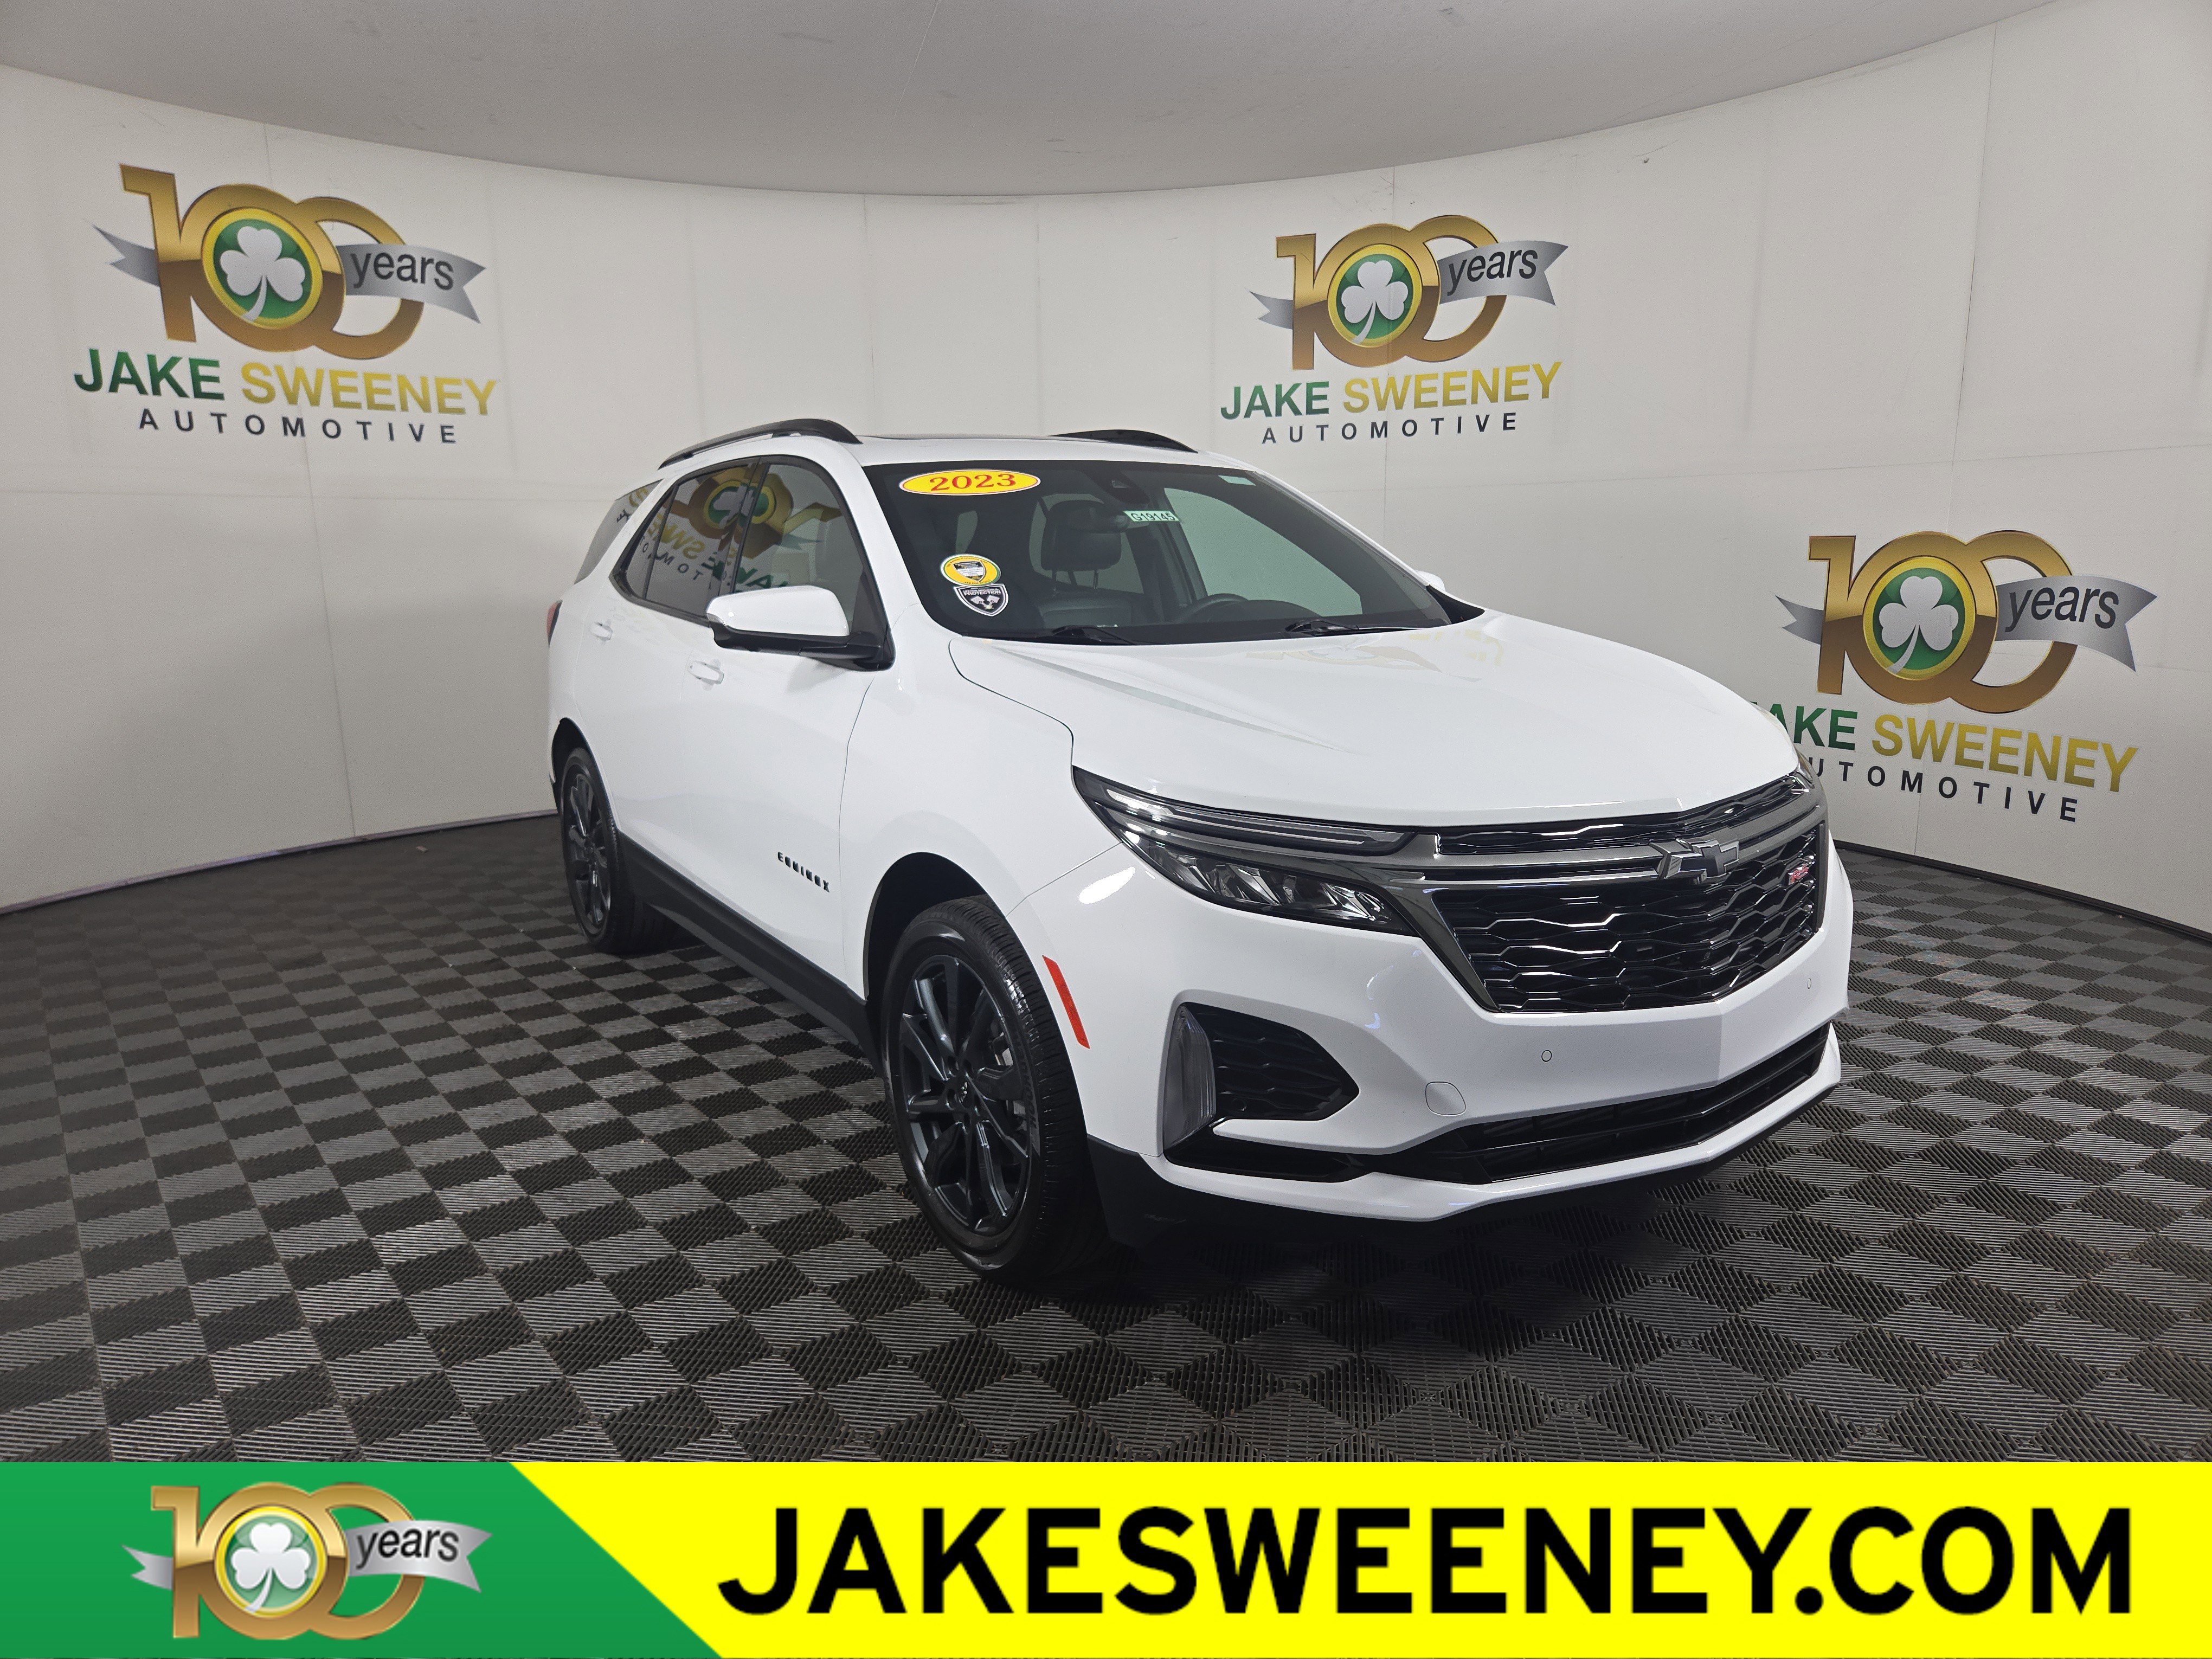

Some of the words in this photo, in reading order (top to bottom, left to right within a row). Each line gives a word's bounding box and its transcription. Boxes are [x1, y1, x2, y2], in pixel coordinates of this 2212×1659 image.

[350, 251, 455, 291] years
[1446, 248, 1538, 296] years
[74, 348, 225, 400] JAKE
[241, 362, 497, 416] SWEENEY
[1220, 381, 1329, 420] JAKE
[1343, 362, 1562, 413] SWEENEY
[138, 408, 458, 443] AUTOMOTIVE
[1262, 413, 1517, 444] AUTOMOTIVE
[929, 474, 1016, 491] 2023
[1130, 512, 1175, 521] G19145
[2004, 586, 2119, 633] years
[1751, 701, 1858, 750] AKE
[1872, 713, 2139, 793] SWEENEY
[1809, 757, 2078, 822] UTOMOTIVE
[777, 851, 830, 893] EQUINOX
